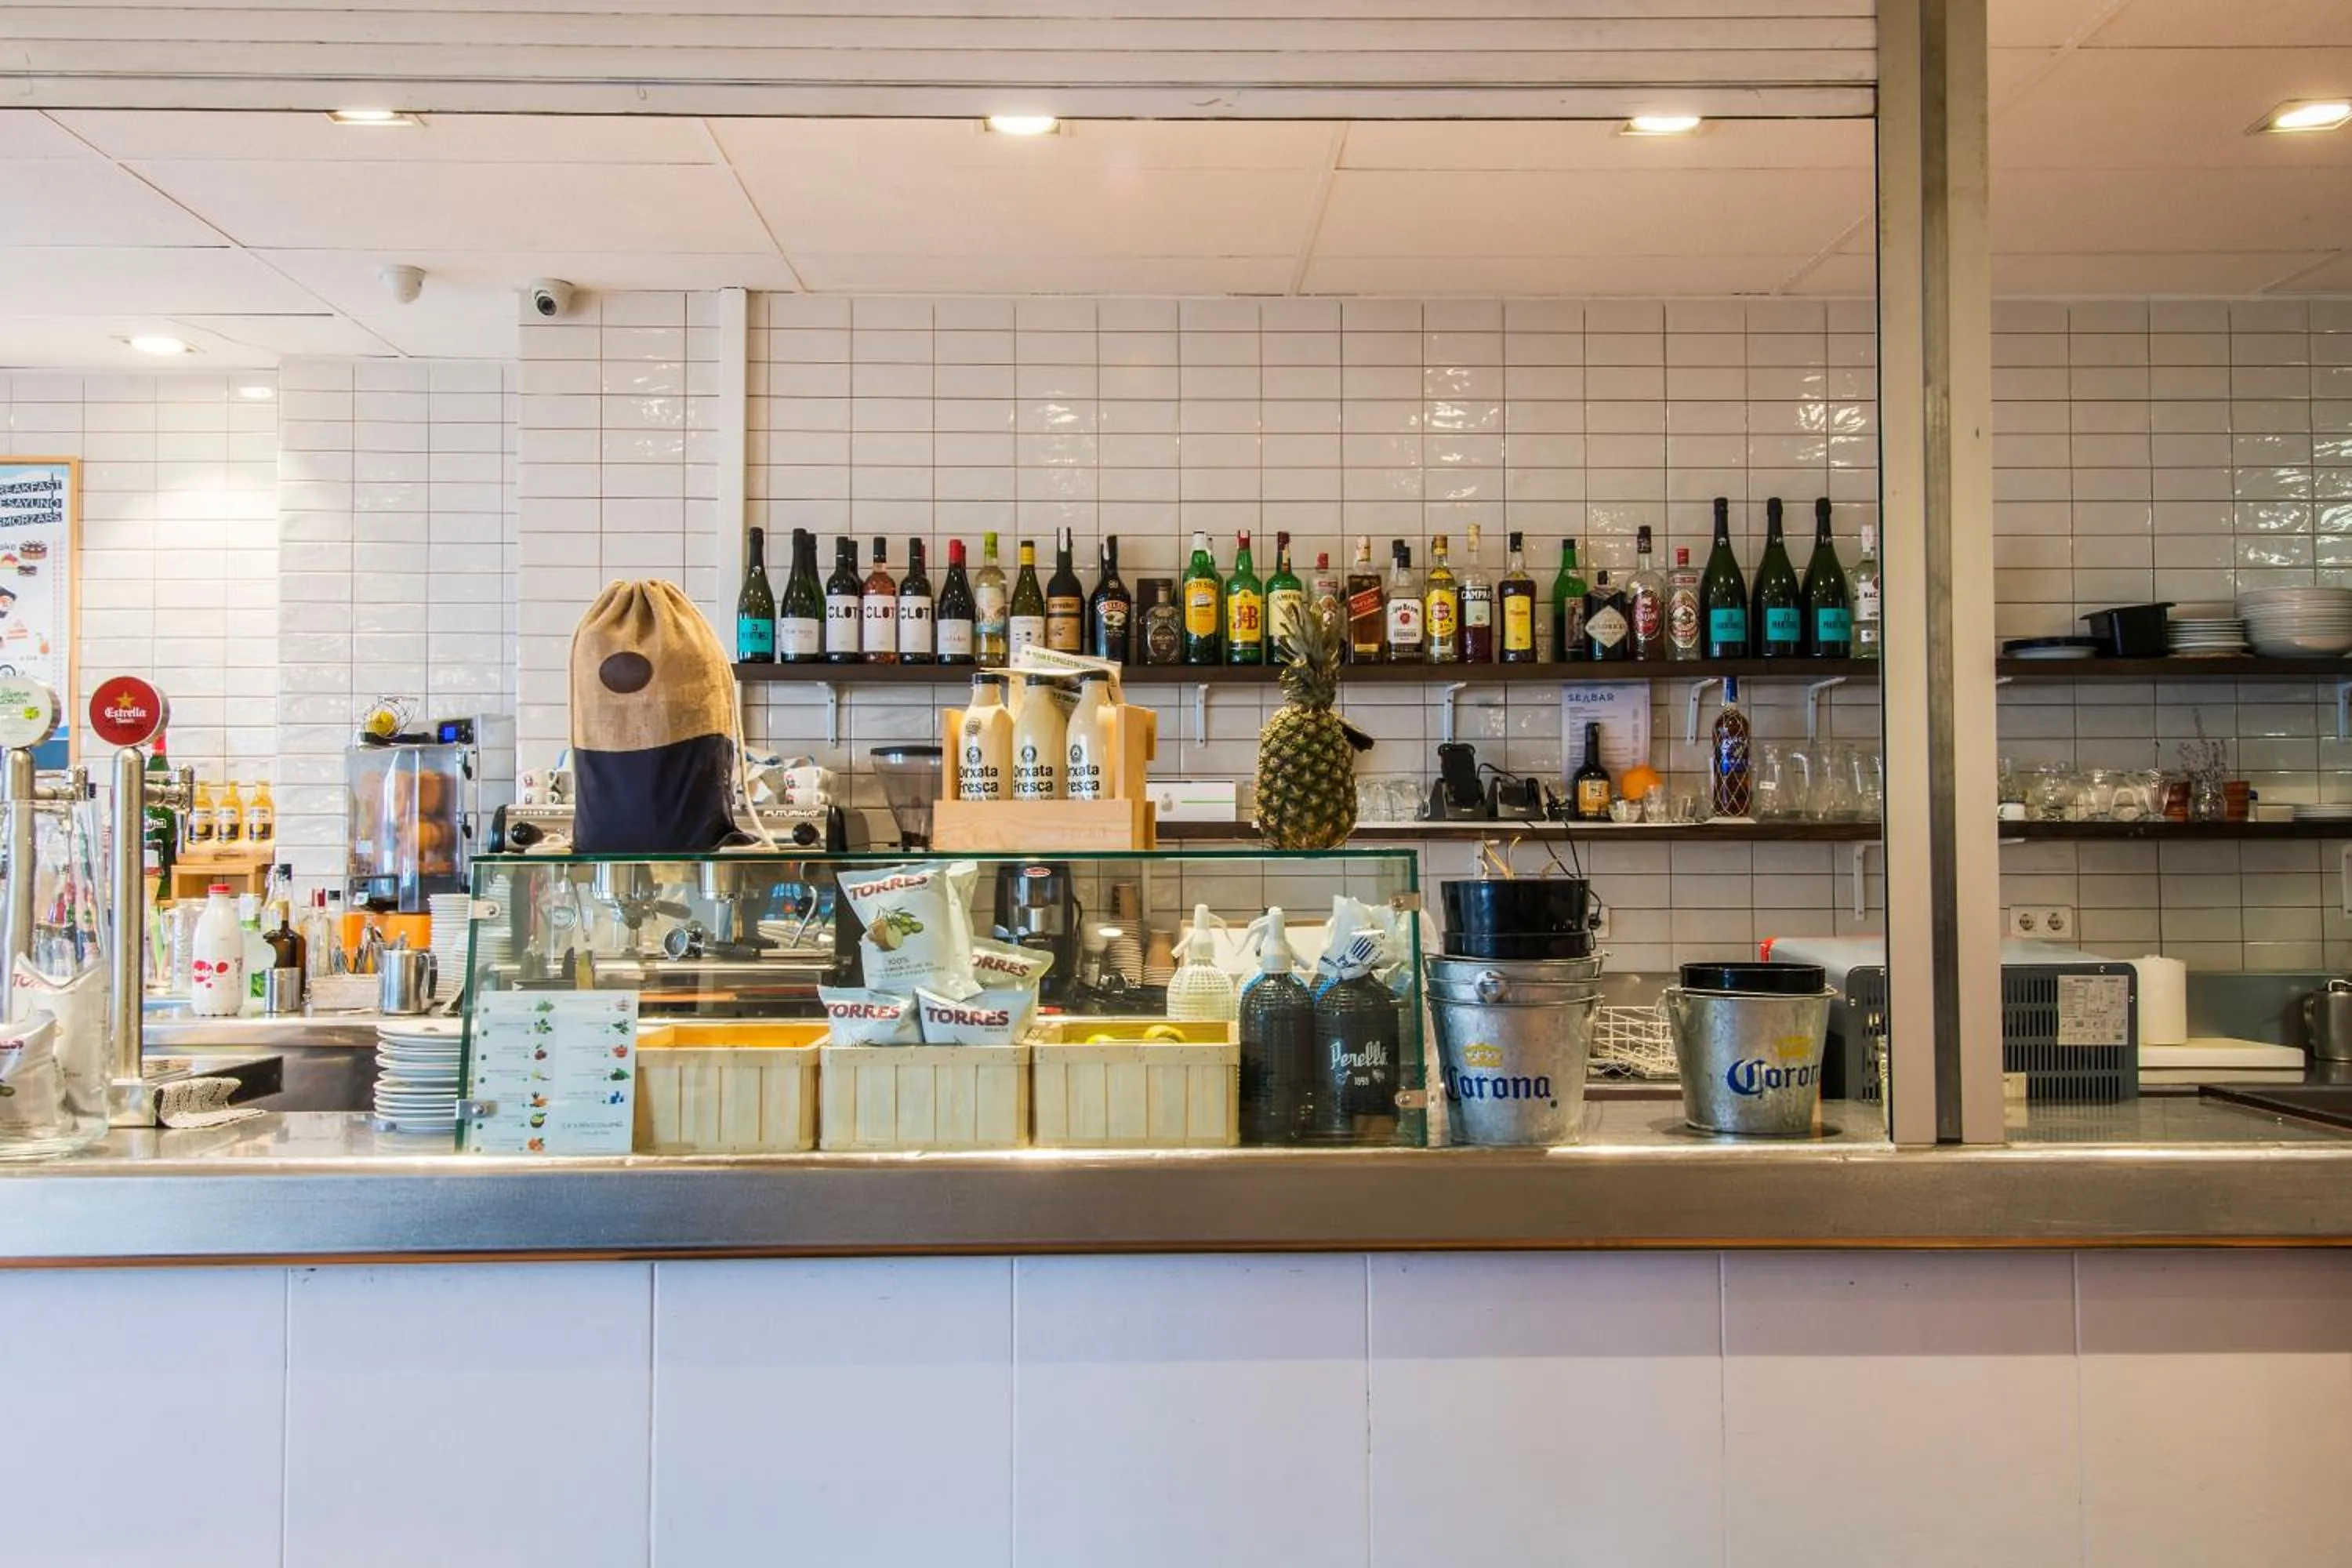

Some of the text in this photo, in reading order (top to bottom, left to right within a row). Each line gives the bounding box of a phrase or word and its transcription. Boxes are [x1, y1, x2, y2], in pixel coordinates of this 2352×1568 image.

[0, 512, 62, 527] MORZARS
[828, 606, 858, 619] CLOT
[866, 606, 895, 619] CLOT
[900, 606, 930, 619] CLOT
[104, 706, 147, 718] Estrella
[1066, 764, 1099, 777] rxata
[1067, 780, 1099, 793] resca
[848, 876, 927, 900] TORRES
[972, 954, 1029, 977] ORRES
[826, 1003, 901, 1018] TORRES
[925, 1006, 1010, 1026] TORRES
[1443, 1065, 1551, 1107] Corona
[1727, 1059, 1820, 1099] Coron
